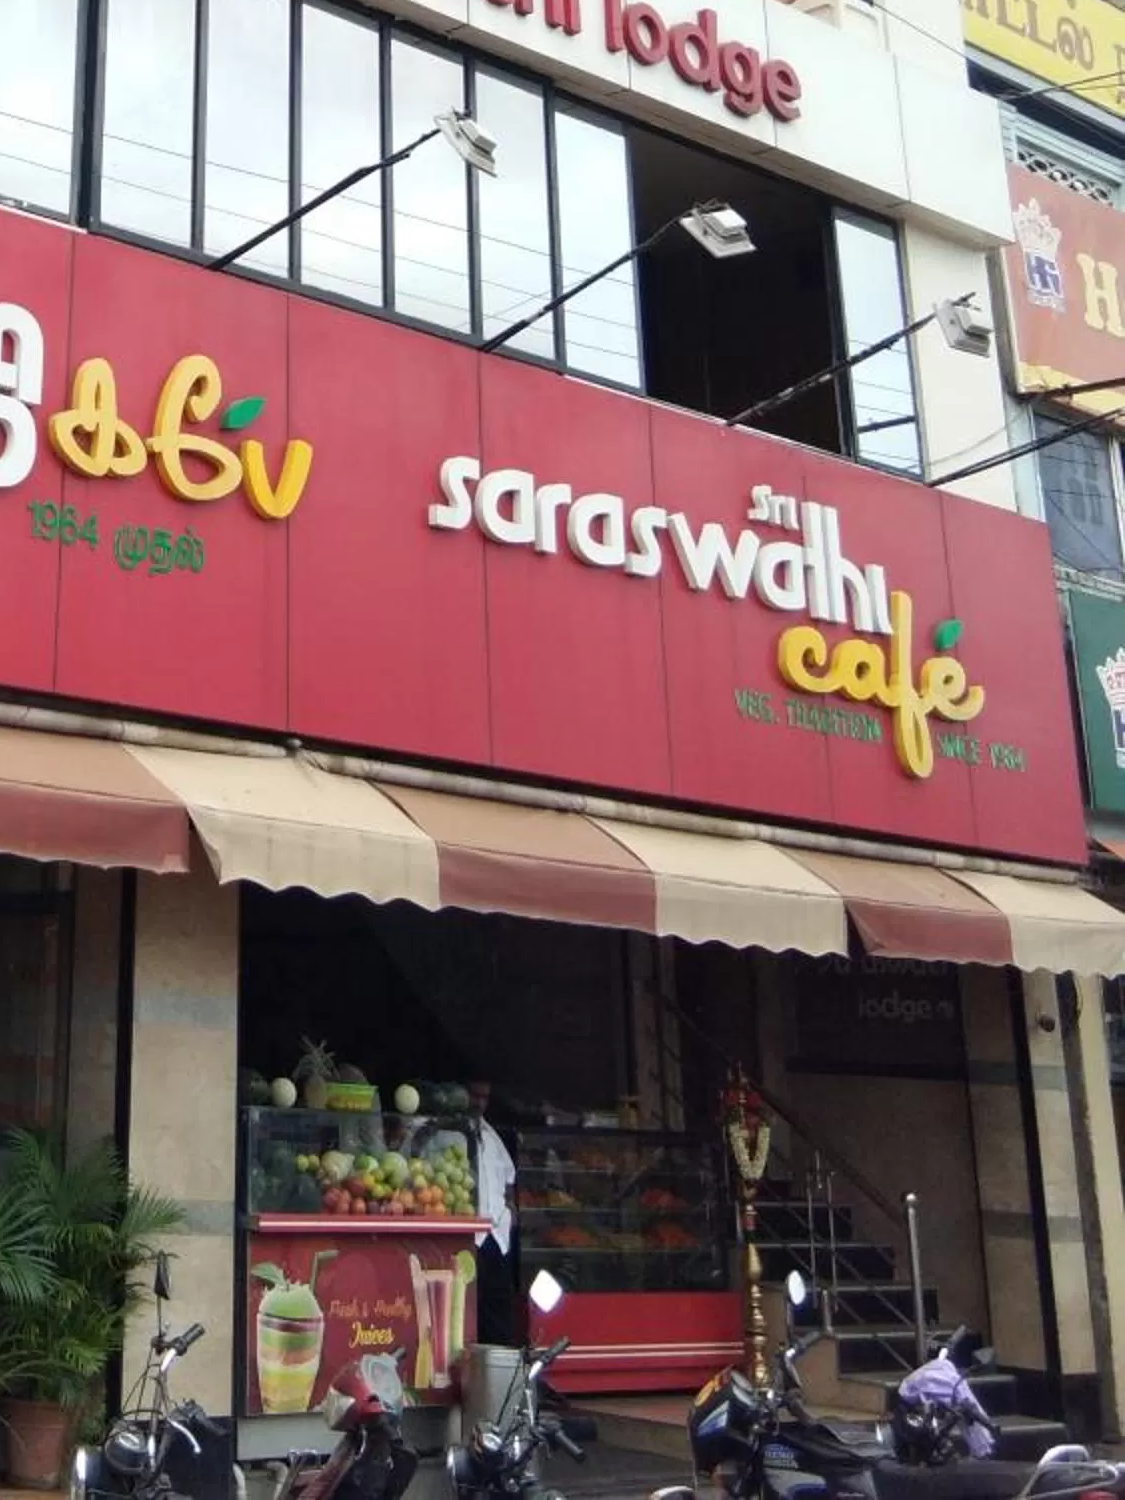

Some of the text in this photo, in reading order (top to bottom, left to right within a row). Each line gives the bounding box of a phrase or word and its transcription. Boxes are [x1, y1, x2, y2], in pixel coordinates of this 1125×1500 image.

[49, 353, 313, 520] கபே
[27, 499, 204, 575] 1964 முதல்
[428, 455, 893, 635] saraswathi
[746, 483, 800, 531] sri
[348, 1321, 395, 1349] Juices
